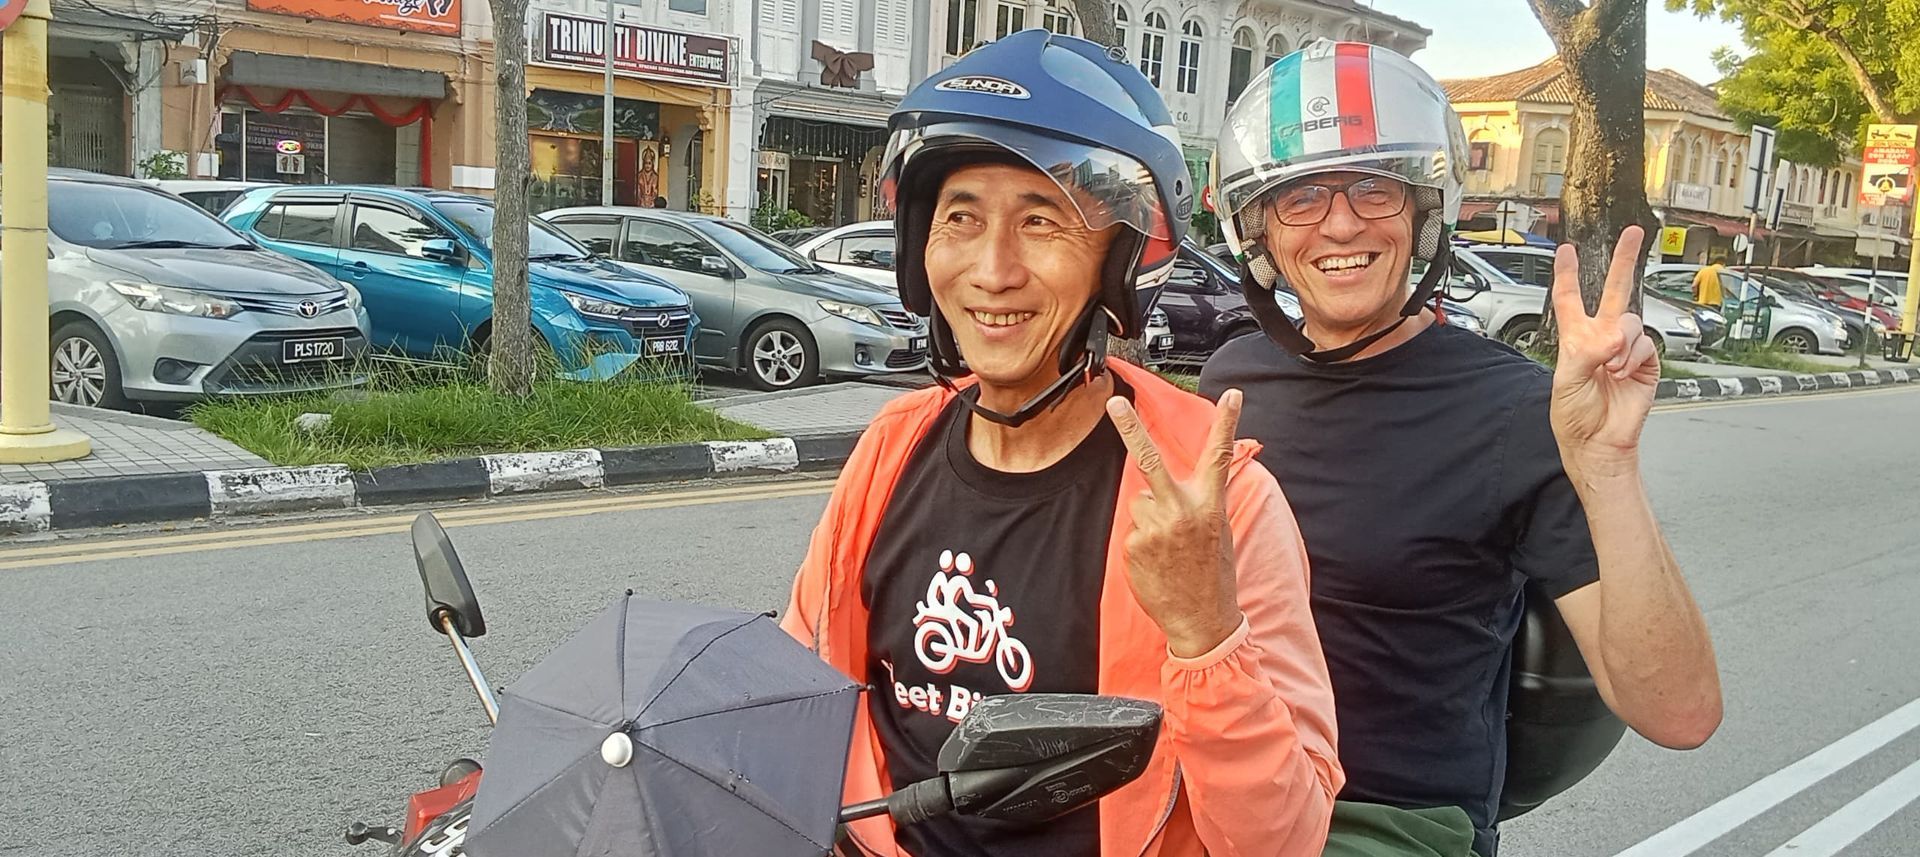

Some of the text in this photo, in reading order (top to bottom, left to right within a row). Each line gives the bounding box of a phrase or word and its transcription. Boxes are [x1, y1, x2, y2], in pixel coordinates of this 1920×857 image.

[550, 17, 688, 67] TRIMUTI DIVINE
[688, 53, 724, 72] ENTERPRISE
